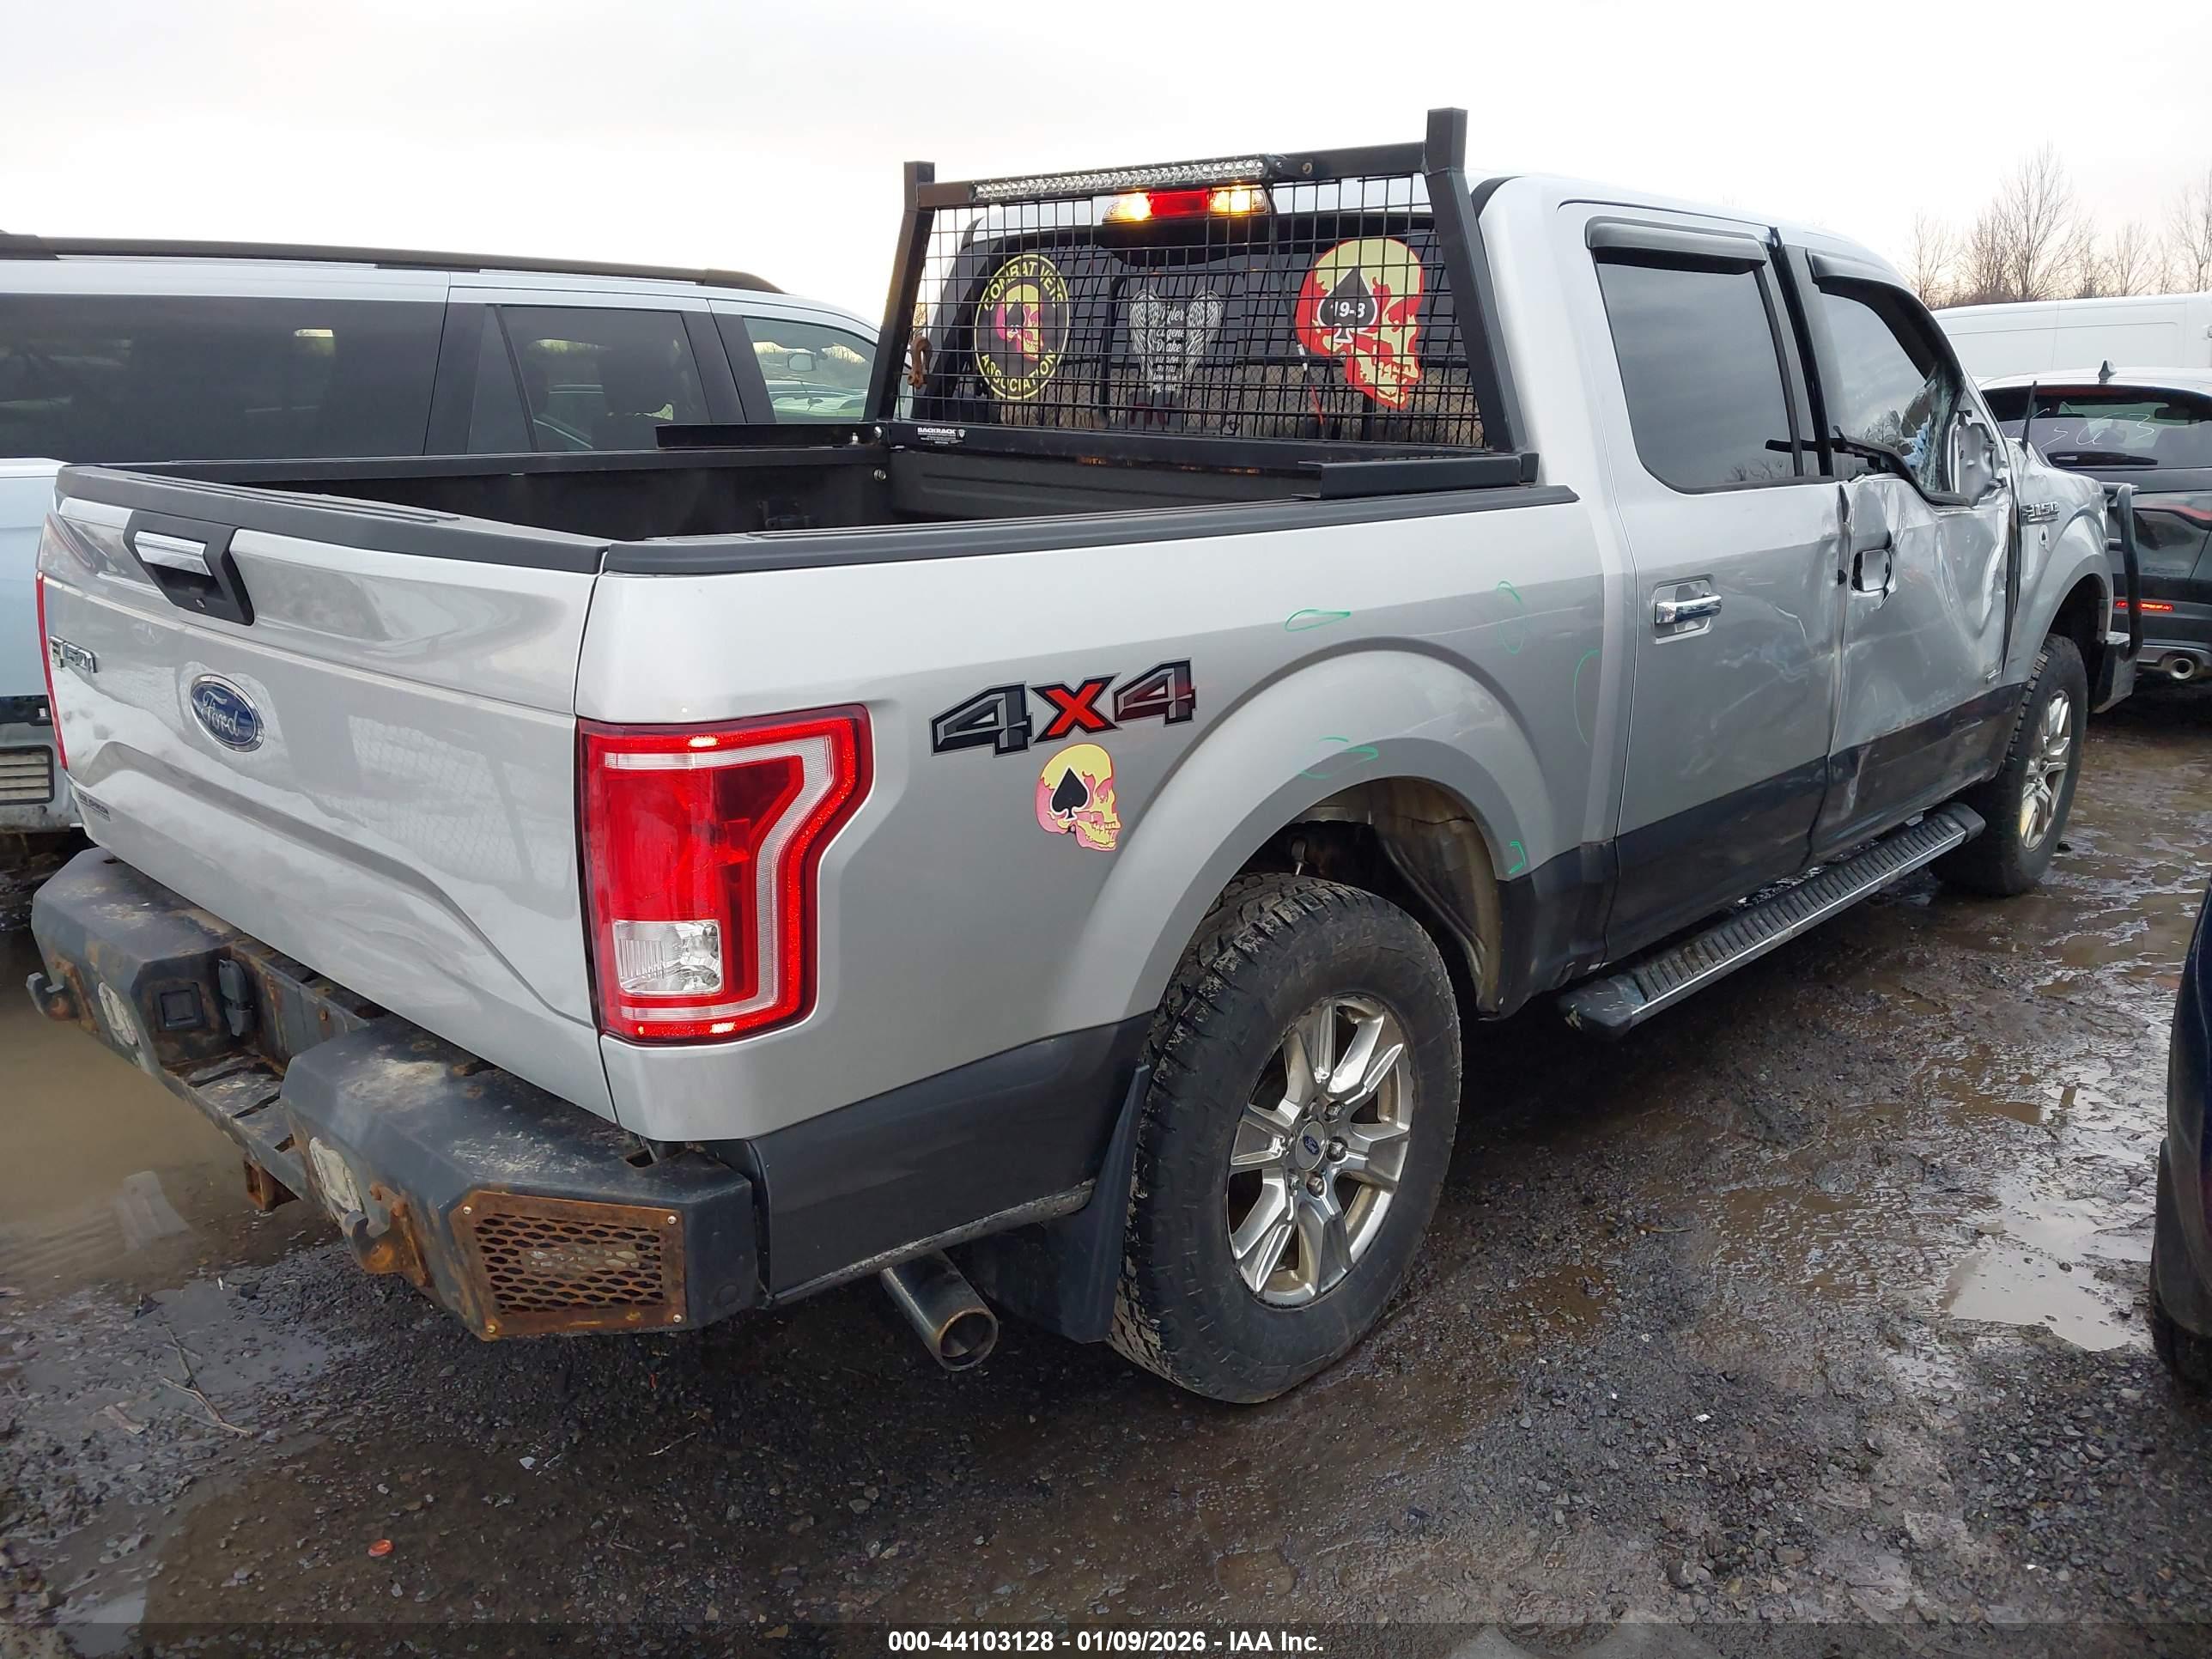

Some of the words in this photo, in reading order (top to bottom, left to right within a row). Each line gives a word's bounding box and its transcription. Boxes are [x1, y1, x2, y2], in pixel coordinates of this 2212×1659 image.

[983, 260, 1037, 311] COMBAT
[1334, 301, 1365, 318] 19-3
[981, 348, 1056, 392] ASSOCIATION
[201, 690, 241, 738] Ford
